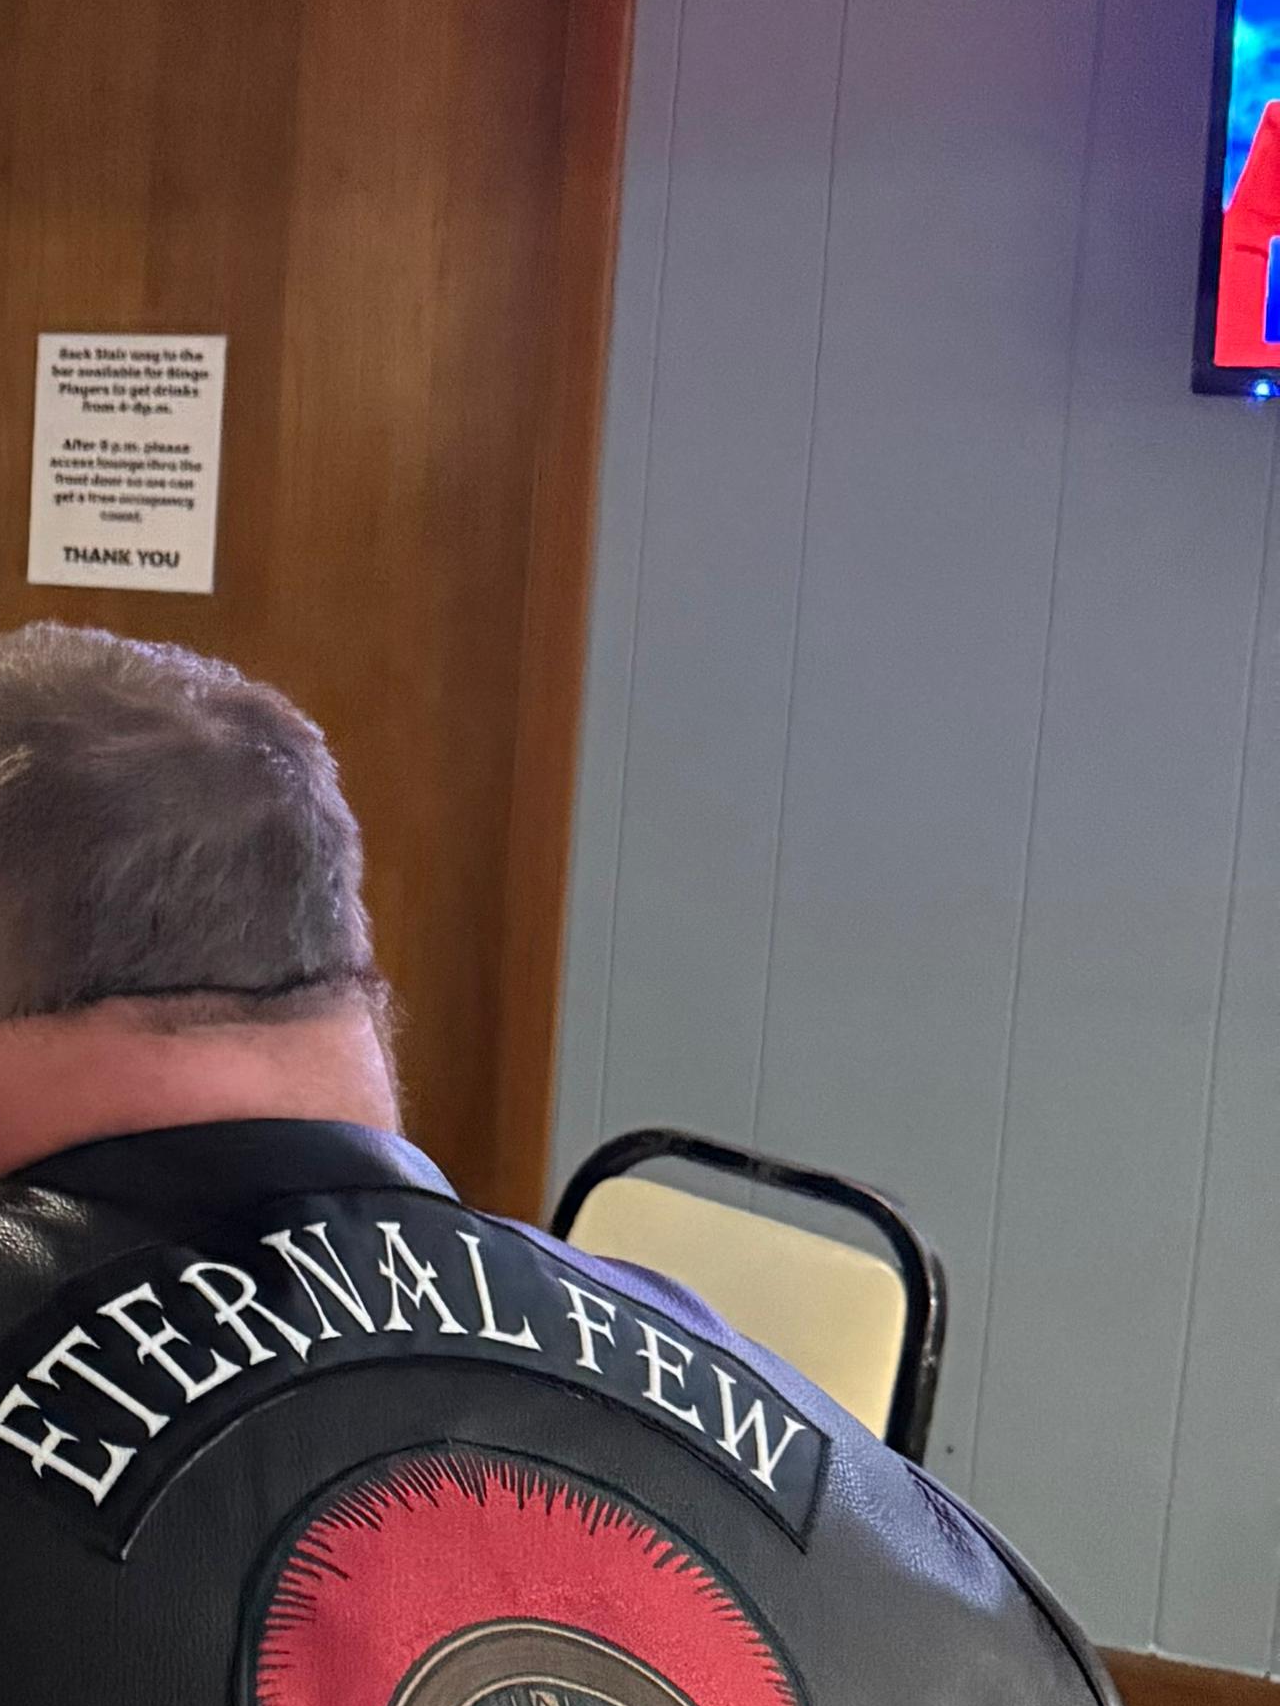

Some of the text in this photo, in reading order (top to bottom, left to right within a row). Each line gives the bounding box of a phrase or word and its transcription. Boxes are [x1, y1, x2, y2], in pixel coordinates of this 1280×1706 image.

[59, 347, 91, 360] Back
[180, 348, 203, 361] the
[51, 365, 209, 382] bar available for Bingo
[58, 382, 199, 400] Players to get drinks
[82, 400, 114, 413] from
[62, 438, 96, 451] After
[143, 441, 191, 454] please
[49, 458, 94, 469] access
[96, 456, 145, 473] lounge
[180, 459, 202, 472] the
[55, 473, 89, 486] front
[91, 474, 122, 487] door
[169, 478, 194, 489] can
[53, 491, 75, 506] get
[76, 493, 85, 502] a
[62, 545, 180, 569] THANK YOU
[559, 1277, 808, 1494] FEW
